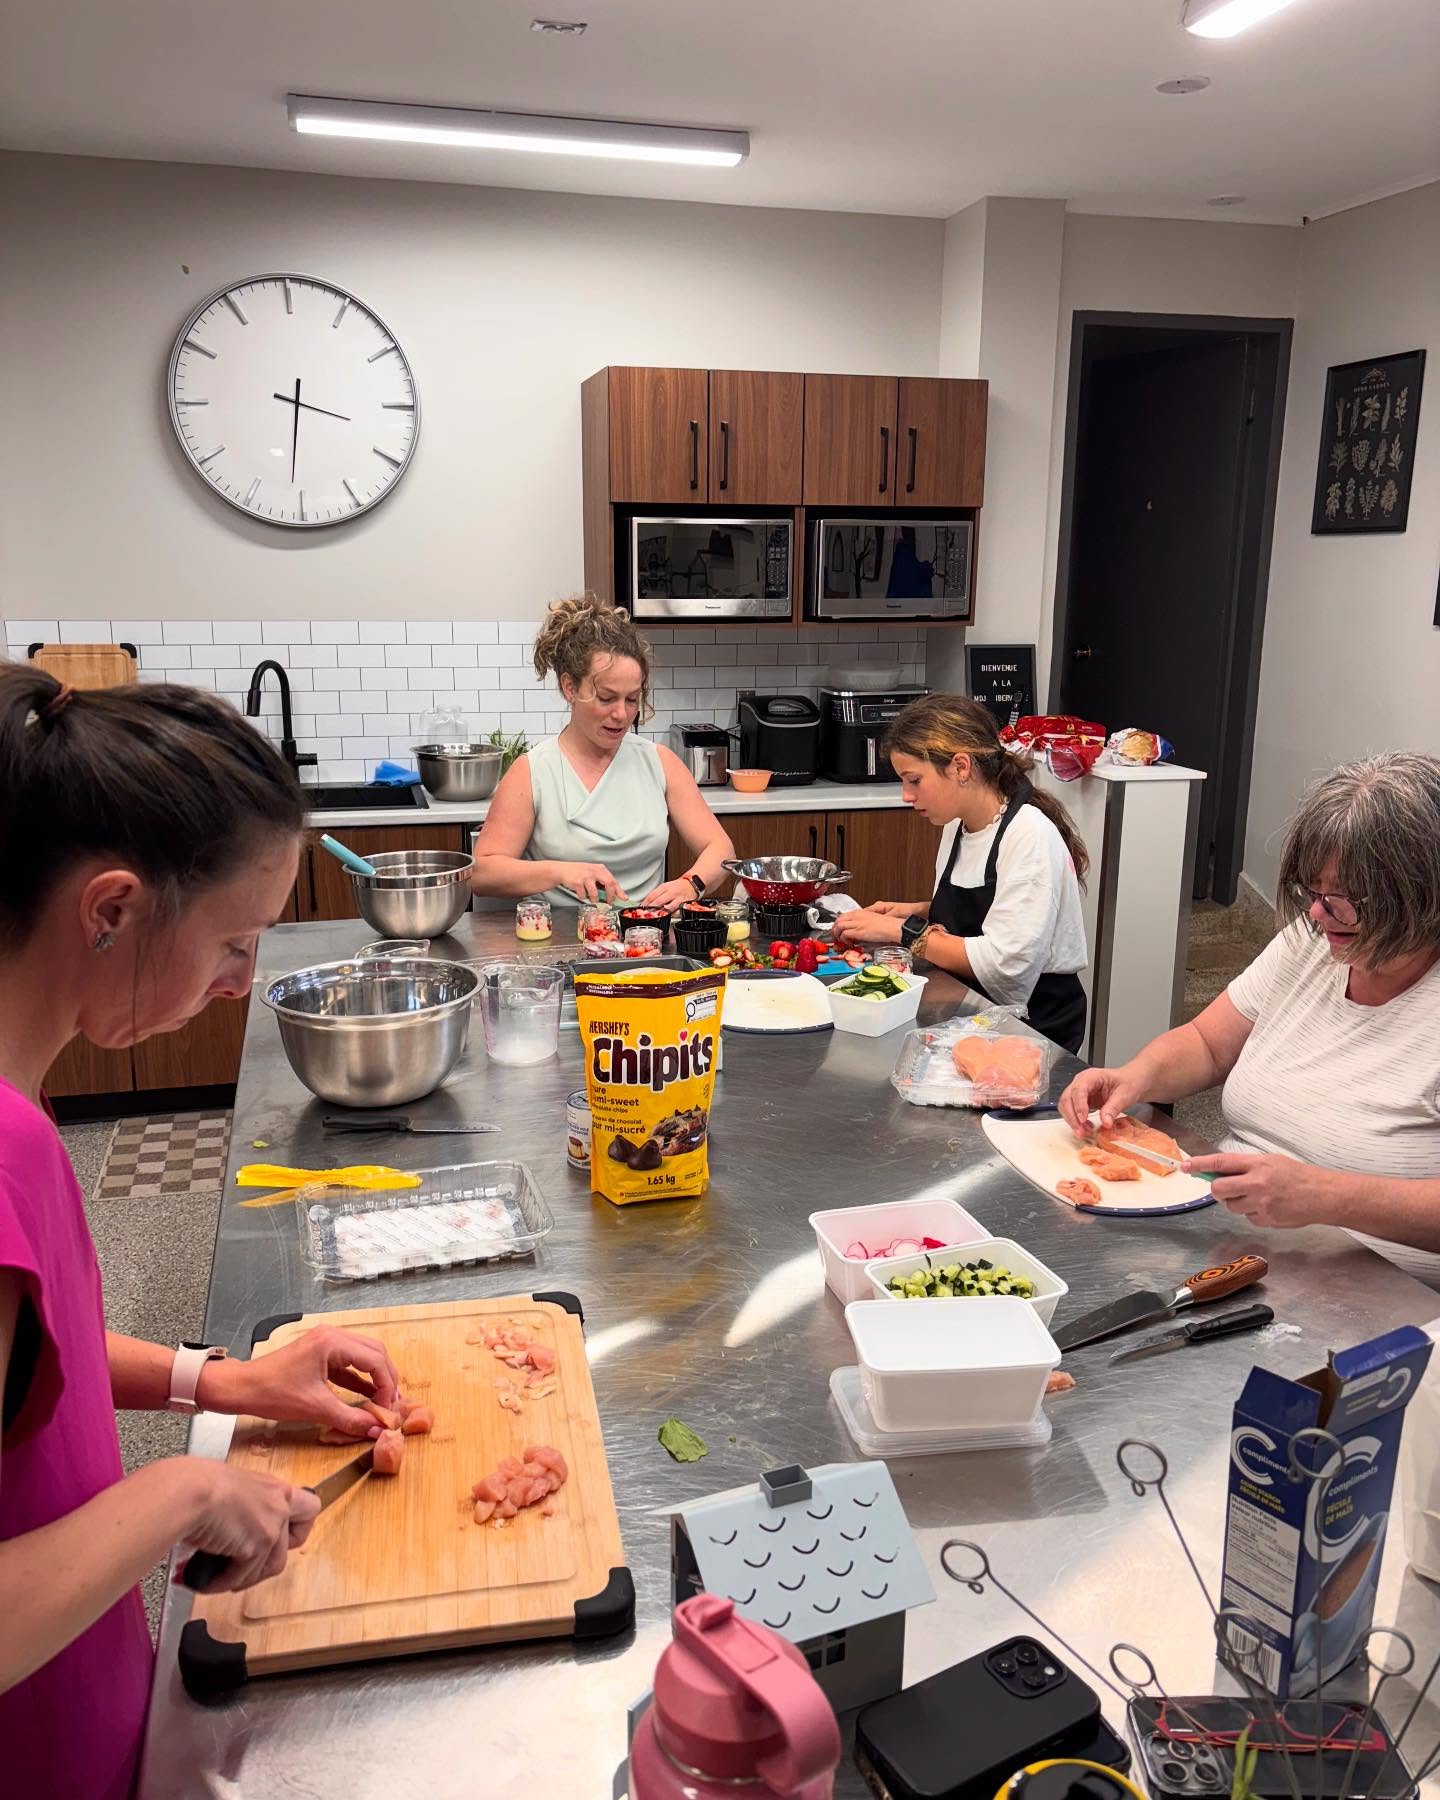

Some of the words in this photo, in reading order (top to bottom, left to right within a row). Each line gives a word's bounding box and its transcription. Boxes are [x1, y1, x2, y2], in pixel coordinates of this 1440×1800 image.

[992, 679, 998, 687] A
[1001, 679, 1012, 687] LA
[589, 1020, 630, 1037] HERSHEY'S
[593, 1033, 713, 1092] Chipits
[604, 1124, 646, 1134] mi-sucré
[647, 1175, 664, 1186] 1.65
[665, 1173, 676, 1185] kg
[1328, 1464, 1379, 1497] compliments
